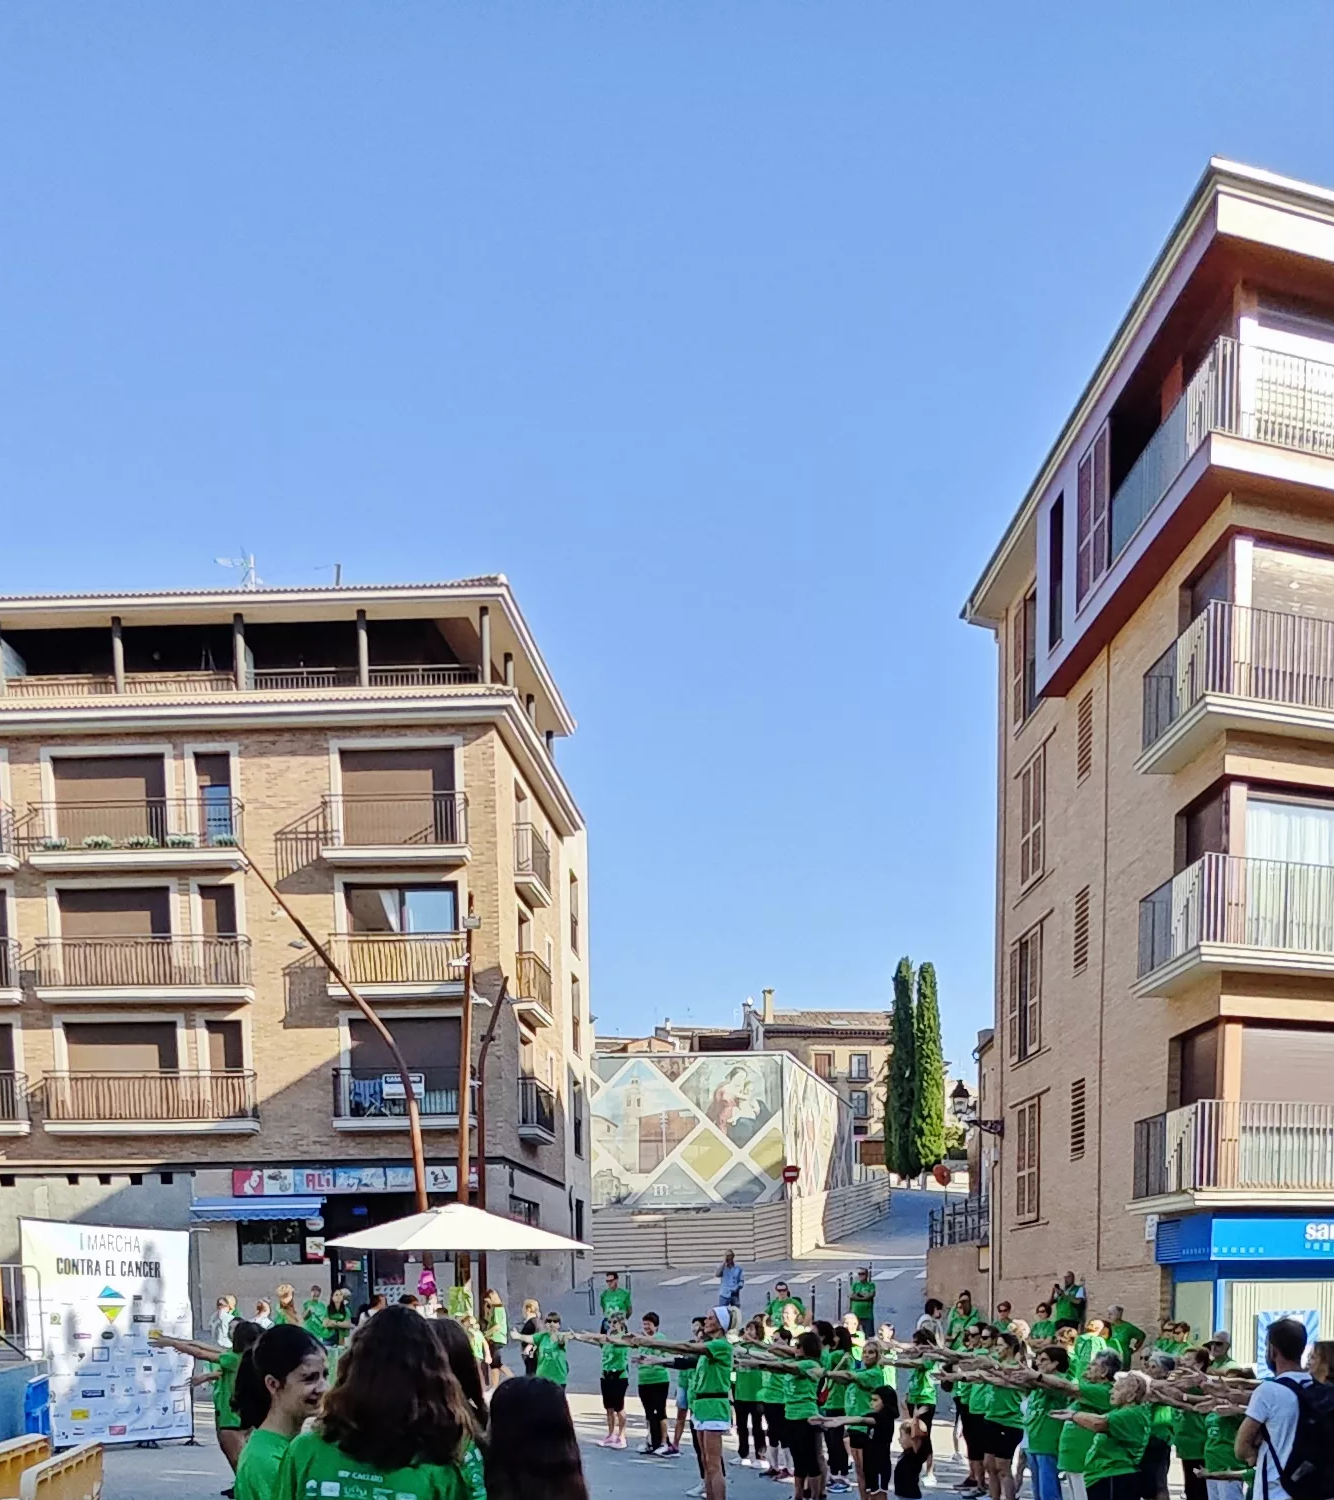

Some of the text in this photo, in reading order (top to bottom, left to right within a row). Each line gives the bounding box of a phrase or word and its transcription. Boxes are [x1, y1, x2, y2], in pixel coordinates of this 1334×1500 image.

[87, 1234, 141, 1253] MARCHA
[56, 1257, 162, 1279] CONTRA EL CANCER
